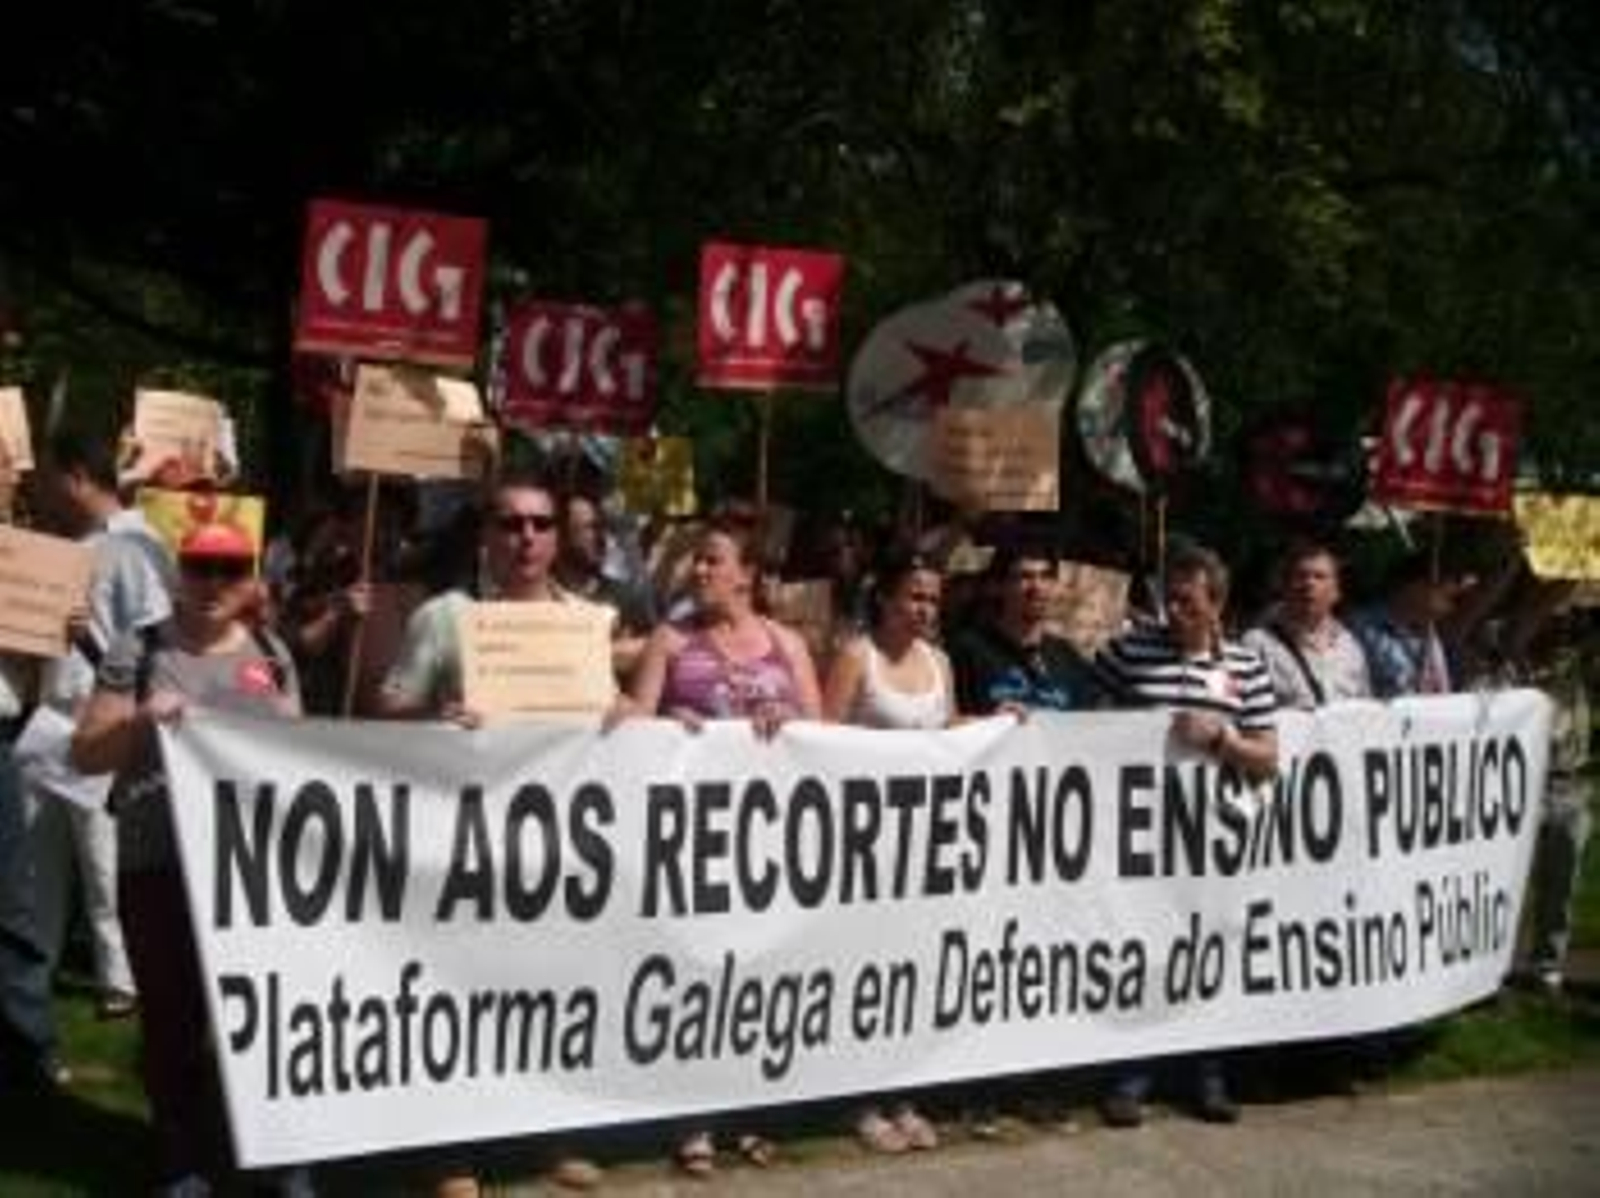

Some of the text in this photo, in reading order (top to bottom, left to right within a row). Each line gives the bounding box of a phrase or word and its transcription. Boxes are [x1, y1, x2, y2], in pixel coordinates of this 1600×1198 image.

[317, 220, 468, 322] CIG
[711, 262, 827, 350] CIG
[523, 314, 646, 401] CIG
[1392, 392, 1500, 481] CIG
[213, 716, 1527, 930] NON AOS RECORTES NO ENSINO PÚBLICO
[217, 959, 600, 1101] Plataforma
[622, 949, 836, 1082] Galega
[850, 957, 919, 1043] en
[932, 918, 1149, 1032] Defensa
[1164, 911, 1227, 1006] do
[1240, 891, 1409, 996] Ensino
